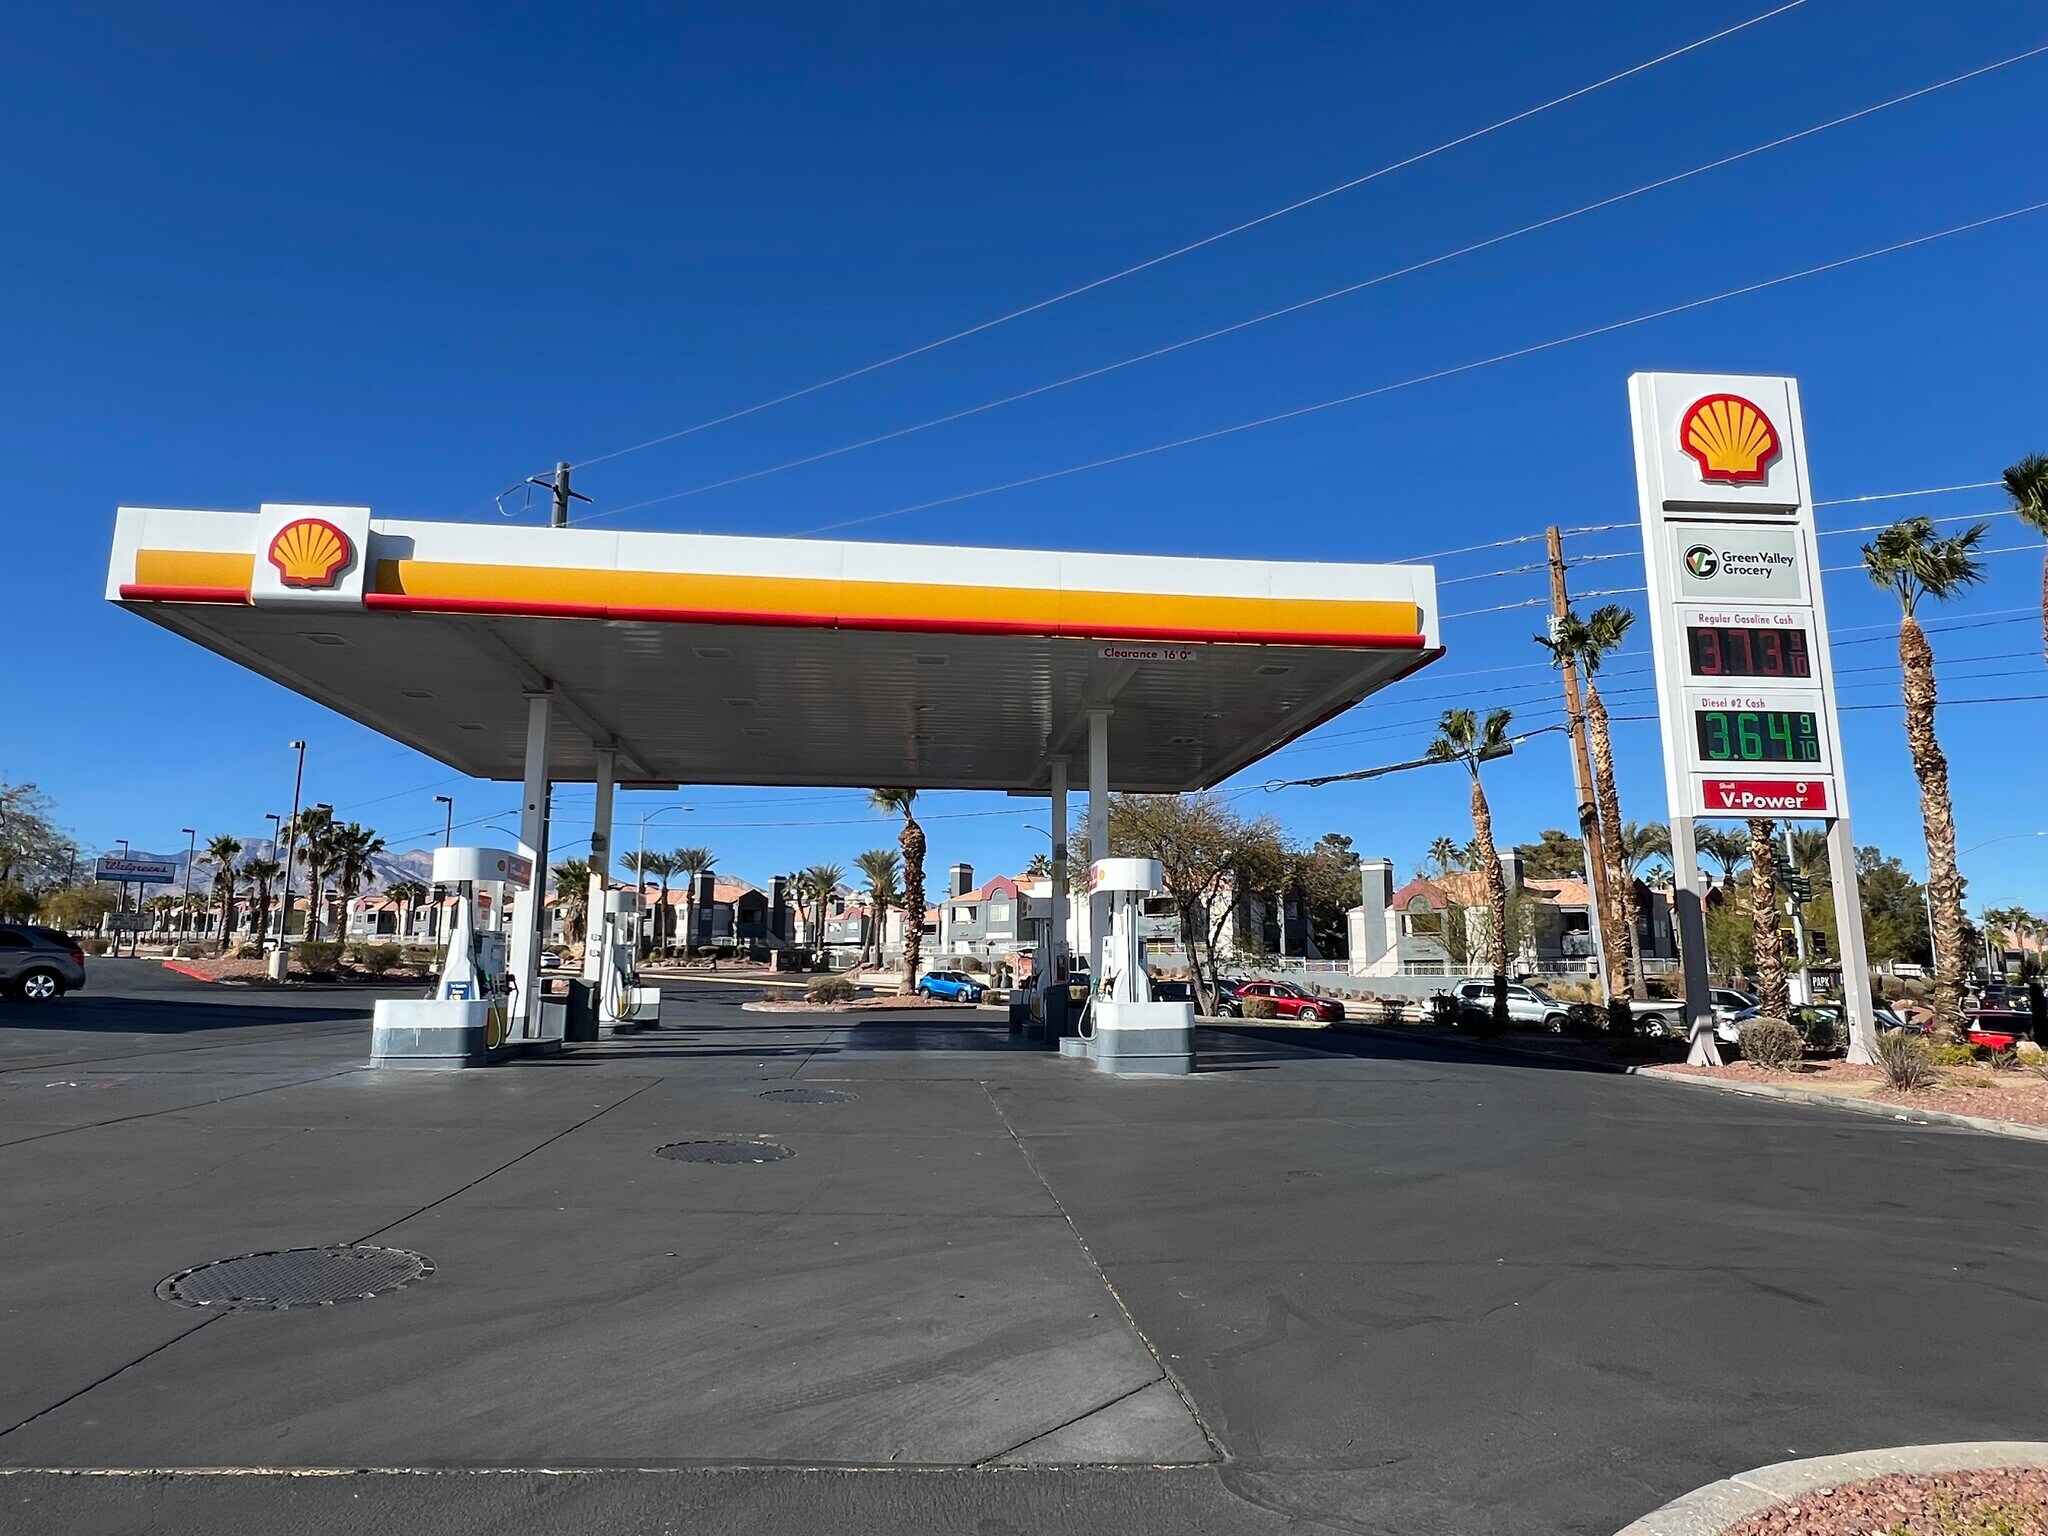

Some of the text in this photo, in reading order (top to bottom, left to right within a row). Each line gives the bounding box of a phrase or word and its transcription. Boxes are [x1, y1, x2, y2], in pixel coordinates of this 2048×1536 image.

[1722, 551, 1794, 567] Green Valley
[1723, 563, 1772, 579] Grocery
[1698, 613, 1793, 625] Regular Gasoline Cash
[1104, 648, 1158, 659] Clearance
[1701, 697, 1766, 708] Diesel #2 Cash
[1719, 791, 1806, 809] V-Power
[105, 860, 168, 873] Walgreens
[1812, 976, 1830, 987] PARK
